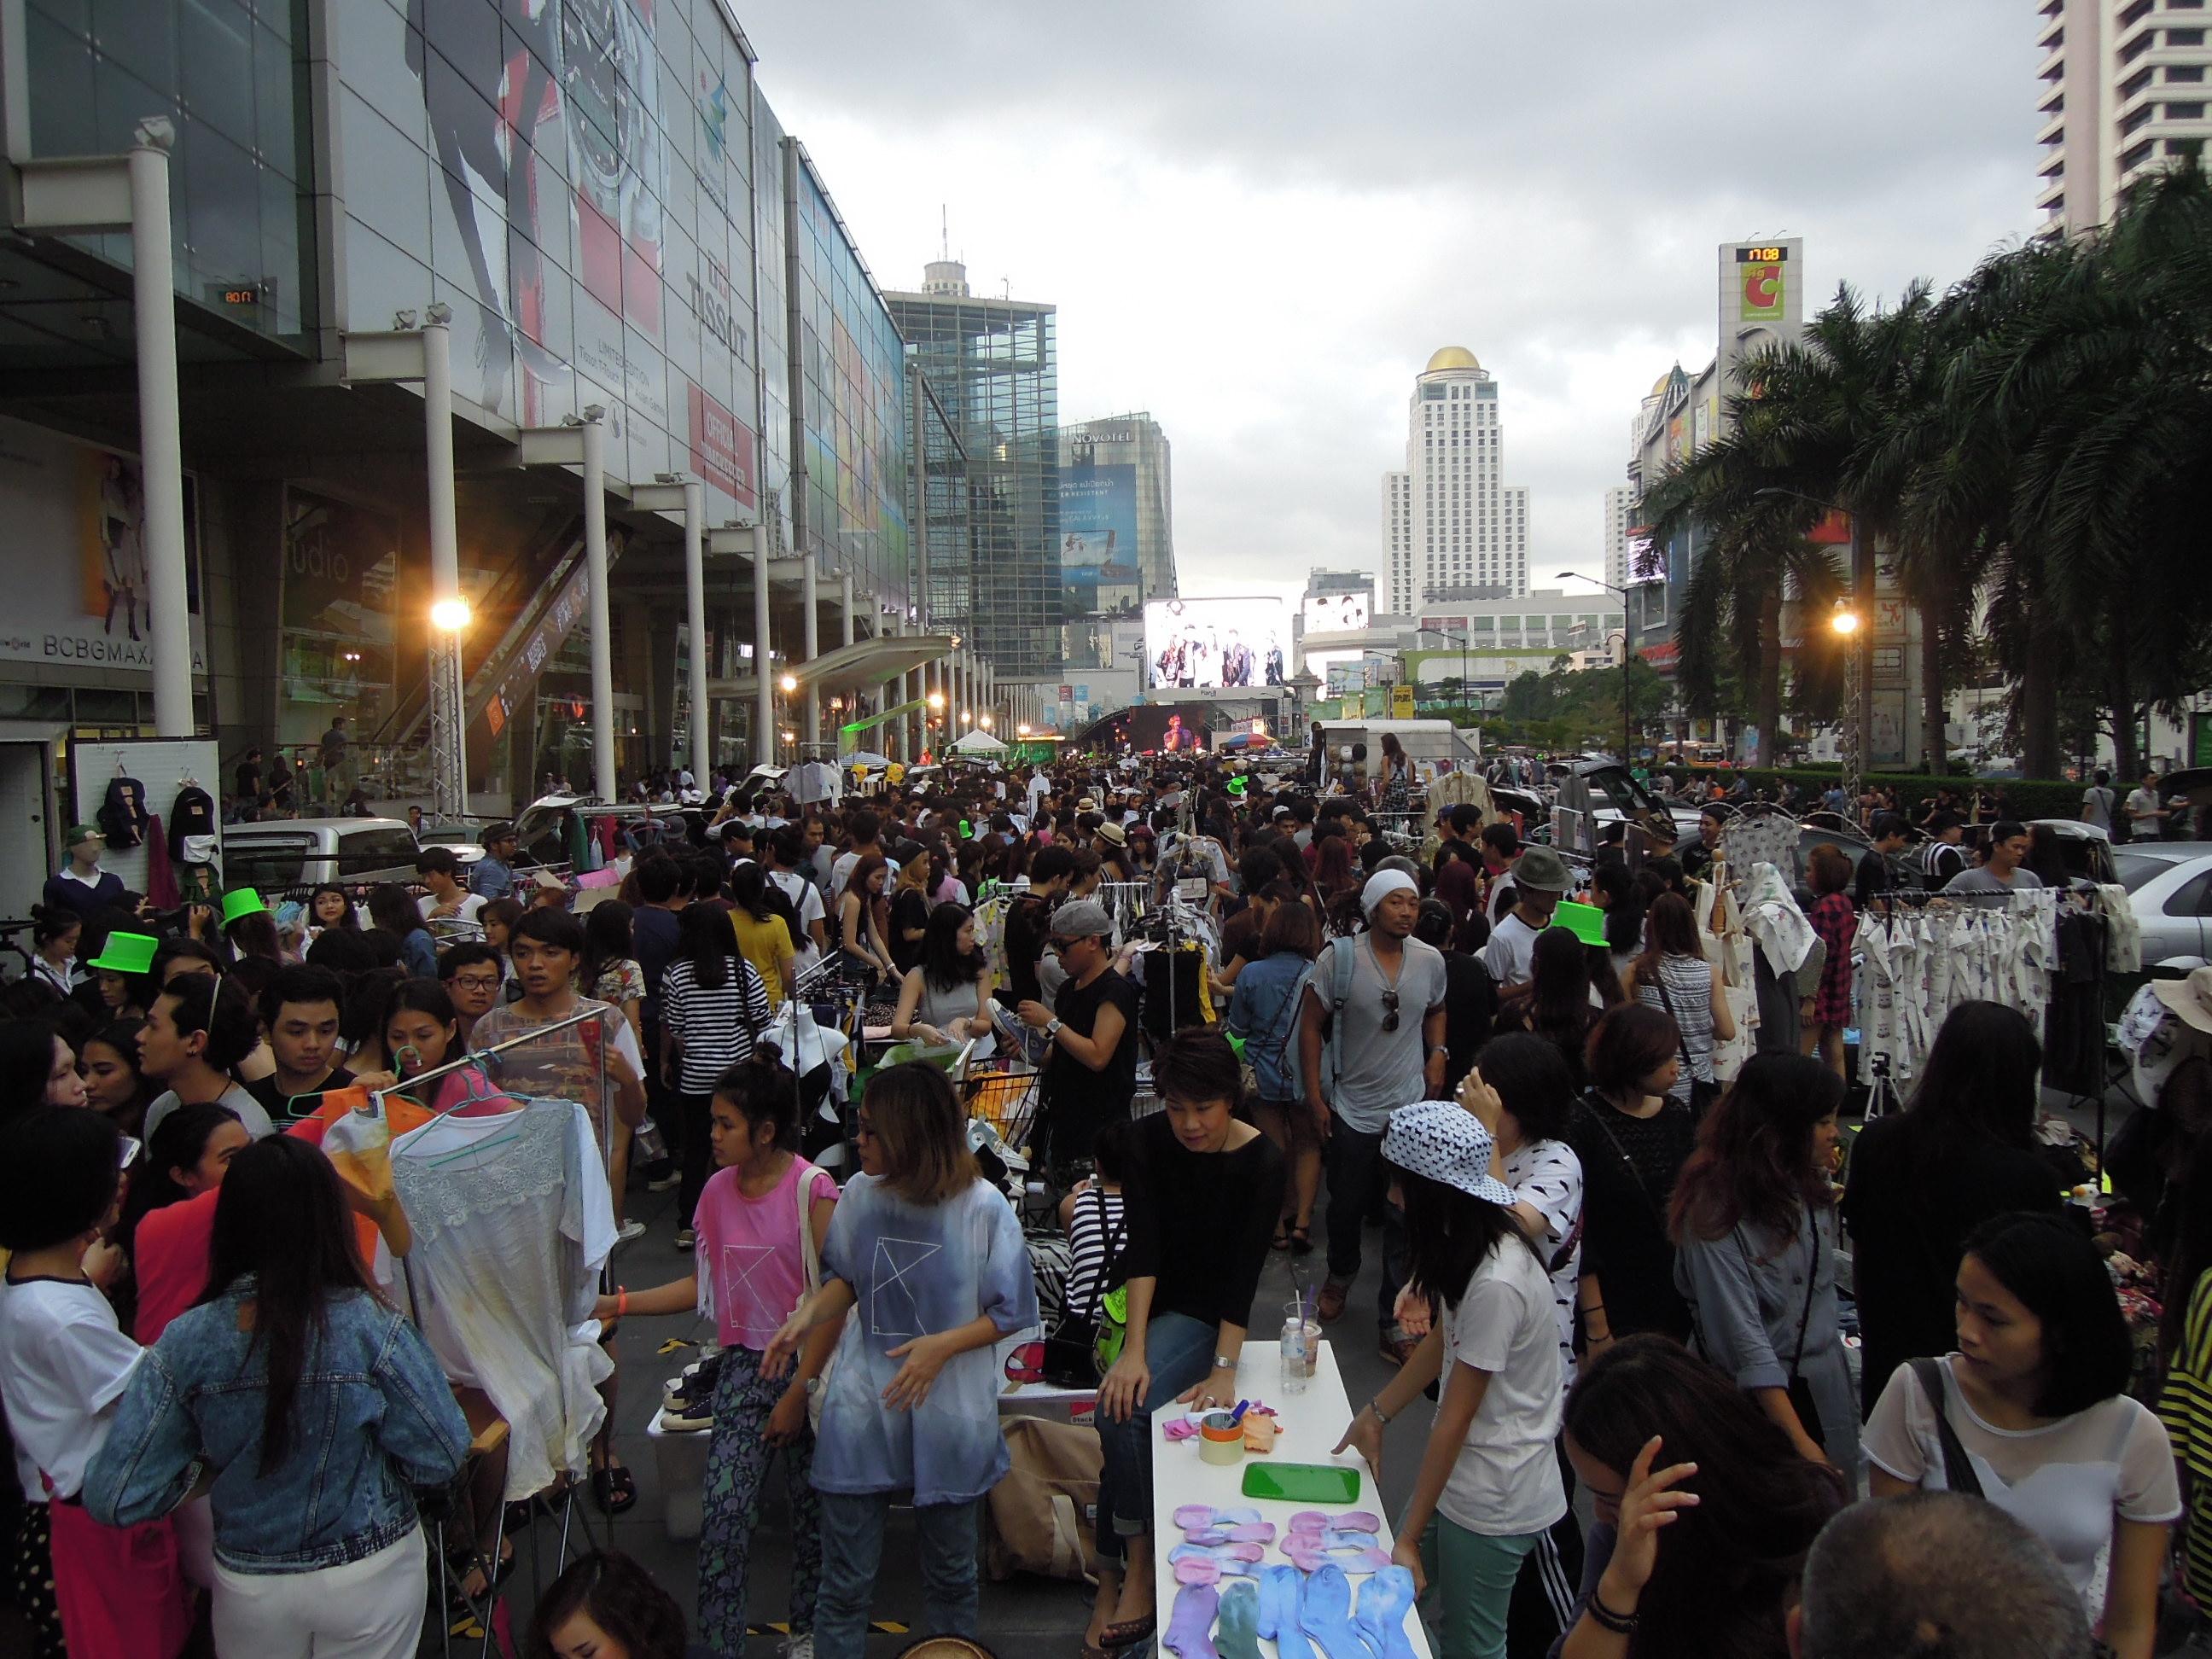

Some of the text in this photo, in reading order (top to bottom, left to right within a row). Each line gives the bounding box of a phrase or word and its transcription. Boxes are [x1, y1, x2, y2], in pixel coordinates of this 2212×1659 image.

[686, 271, 748, 364] TISSOT
[707, 411, 739, 458] OFFICIAL
[1073, 432, 1132, 444] NOVOTEL
